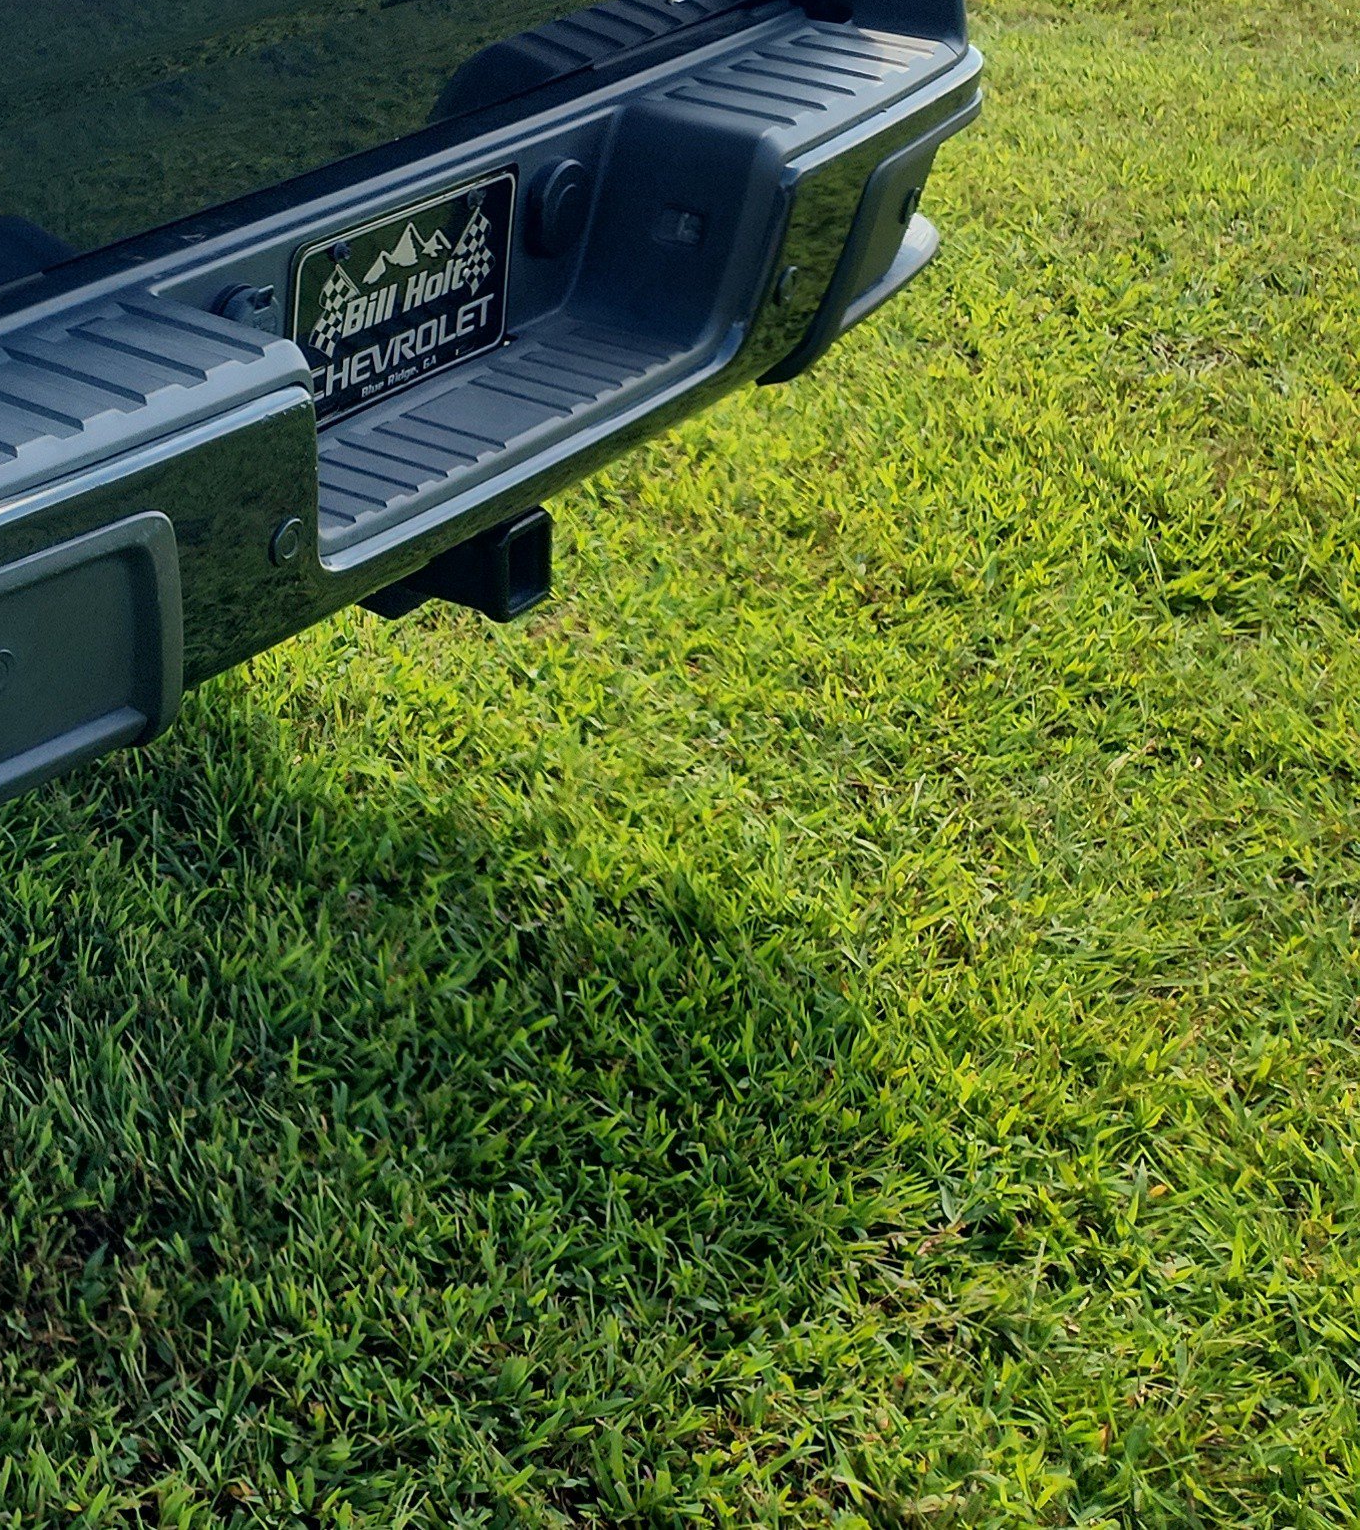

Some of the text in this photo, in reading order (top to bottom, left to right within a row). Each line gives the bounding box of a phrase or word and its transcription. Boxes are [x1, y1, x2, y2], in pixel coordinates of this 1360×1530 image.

[341, 257, 469, 339] Bill Holt
[361, 380, 384, 398] Blue
[422, 354, 437, 370] GA
